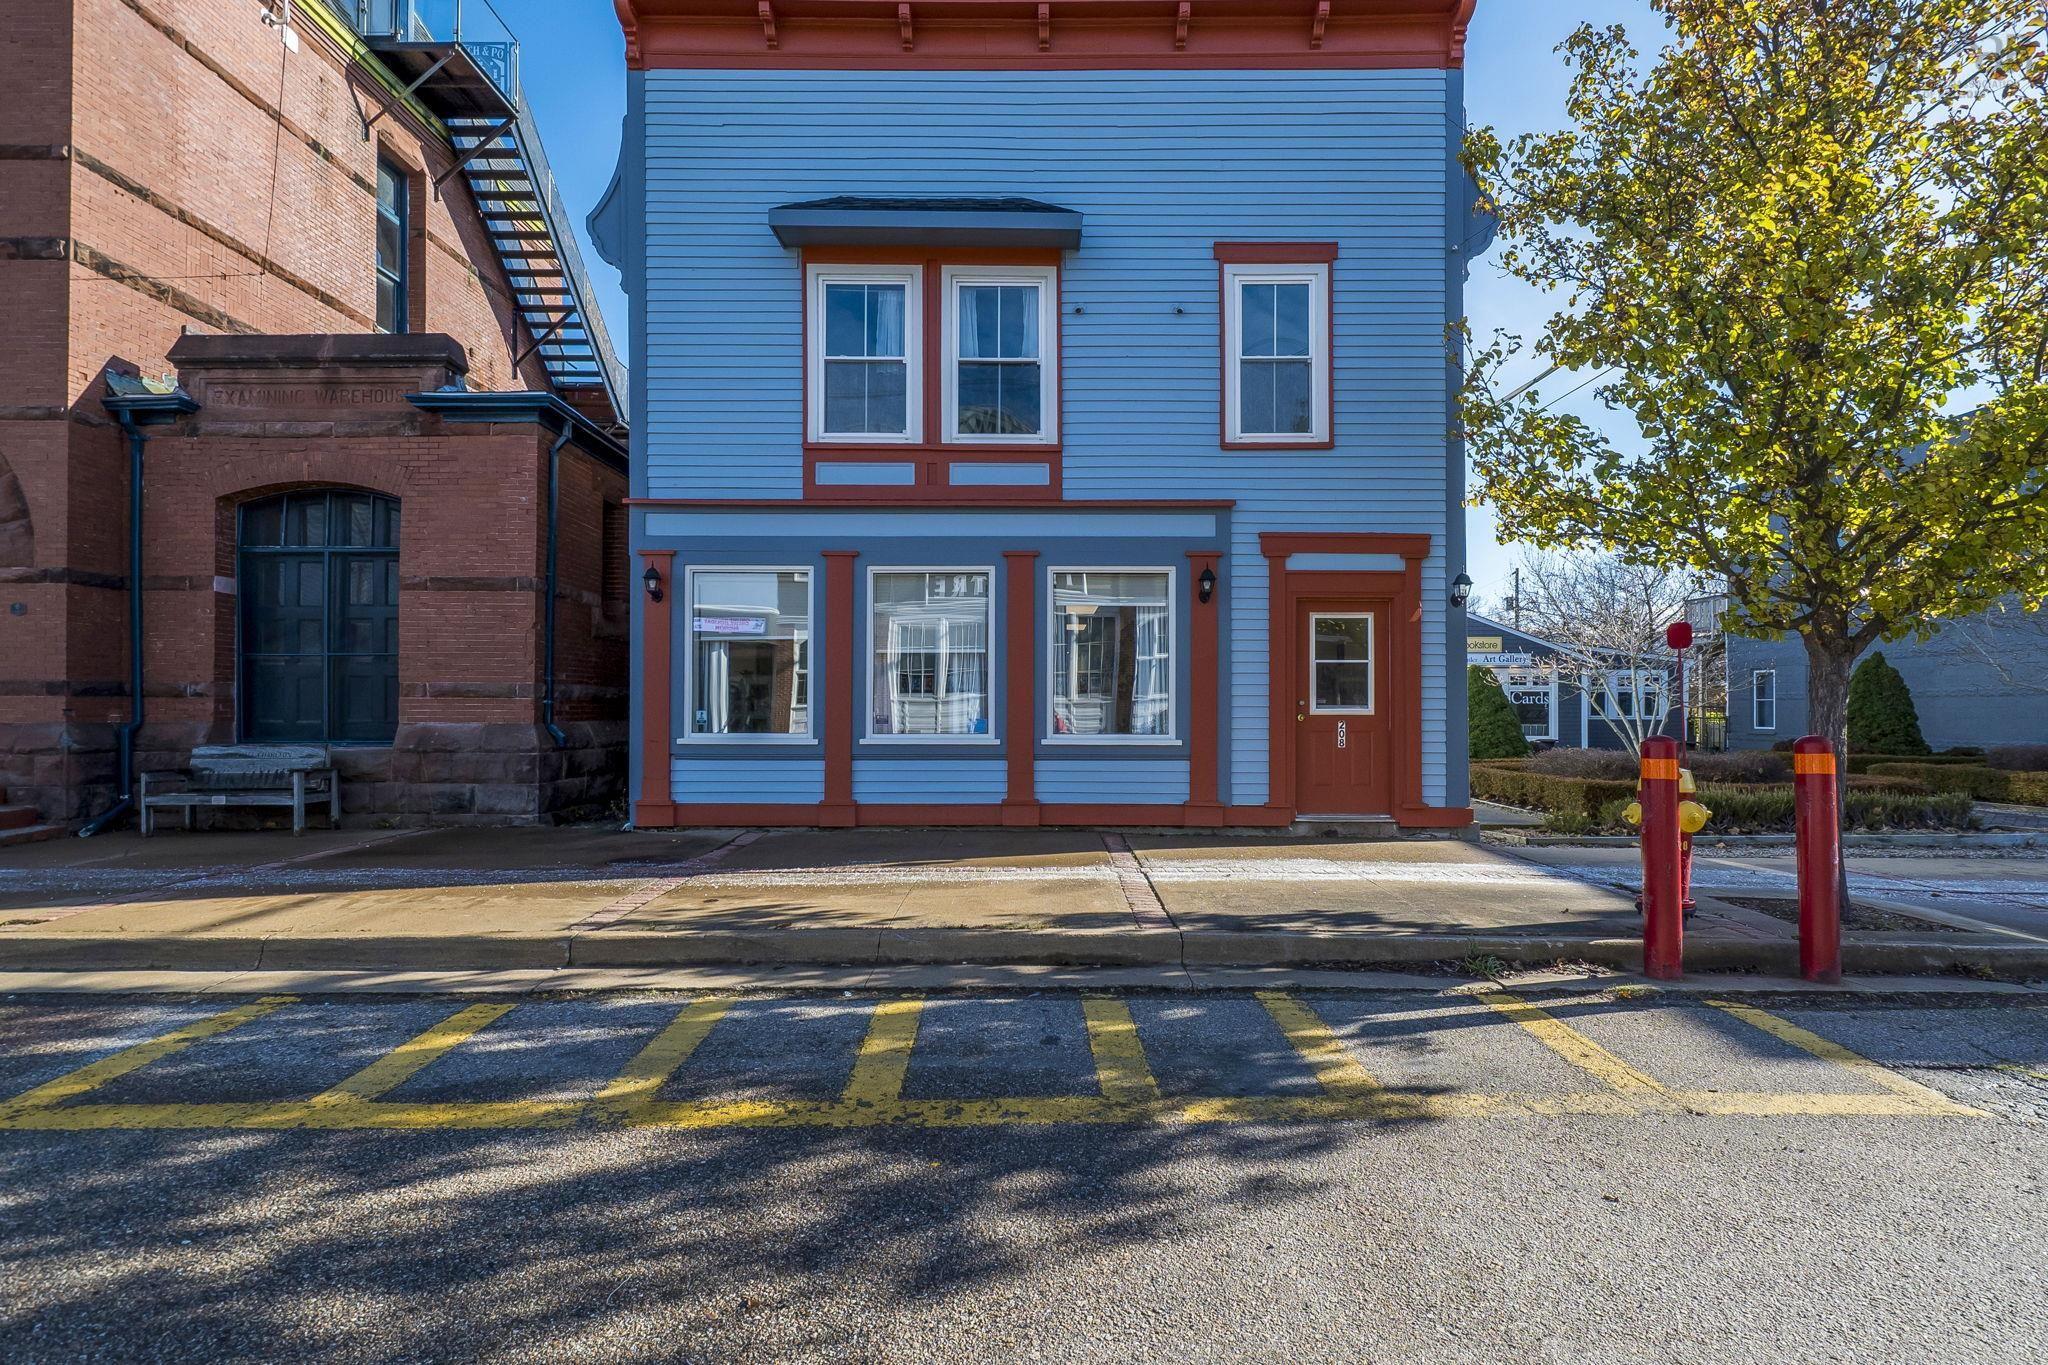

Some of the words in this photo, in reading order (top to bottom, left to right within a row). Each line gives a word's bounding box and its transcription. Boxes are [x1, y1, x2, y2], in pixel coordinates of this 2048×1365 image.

[482, 46, 489, 56] &
[213, 388, 304, 405] EXAMINING
[1467, 640, 1498, 650] ookstore
[1482, 655, 1495, 663] Art
[1498, 655, 1527, 664] Gallery
[1511, 691, 1549, 704] Cards
